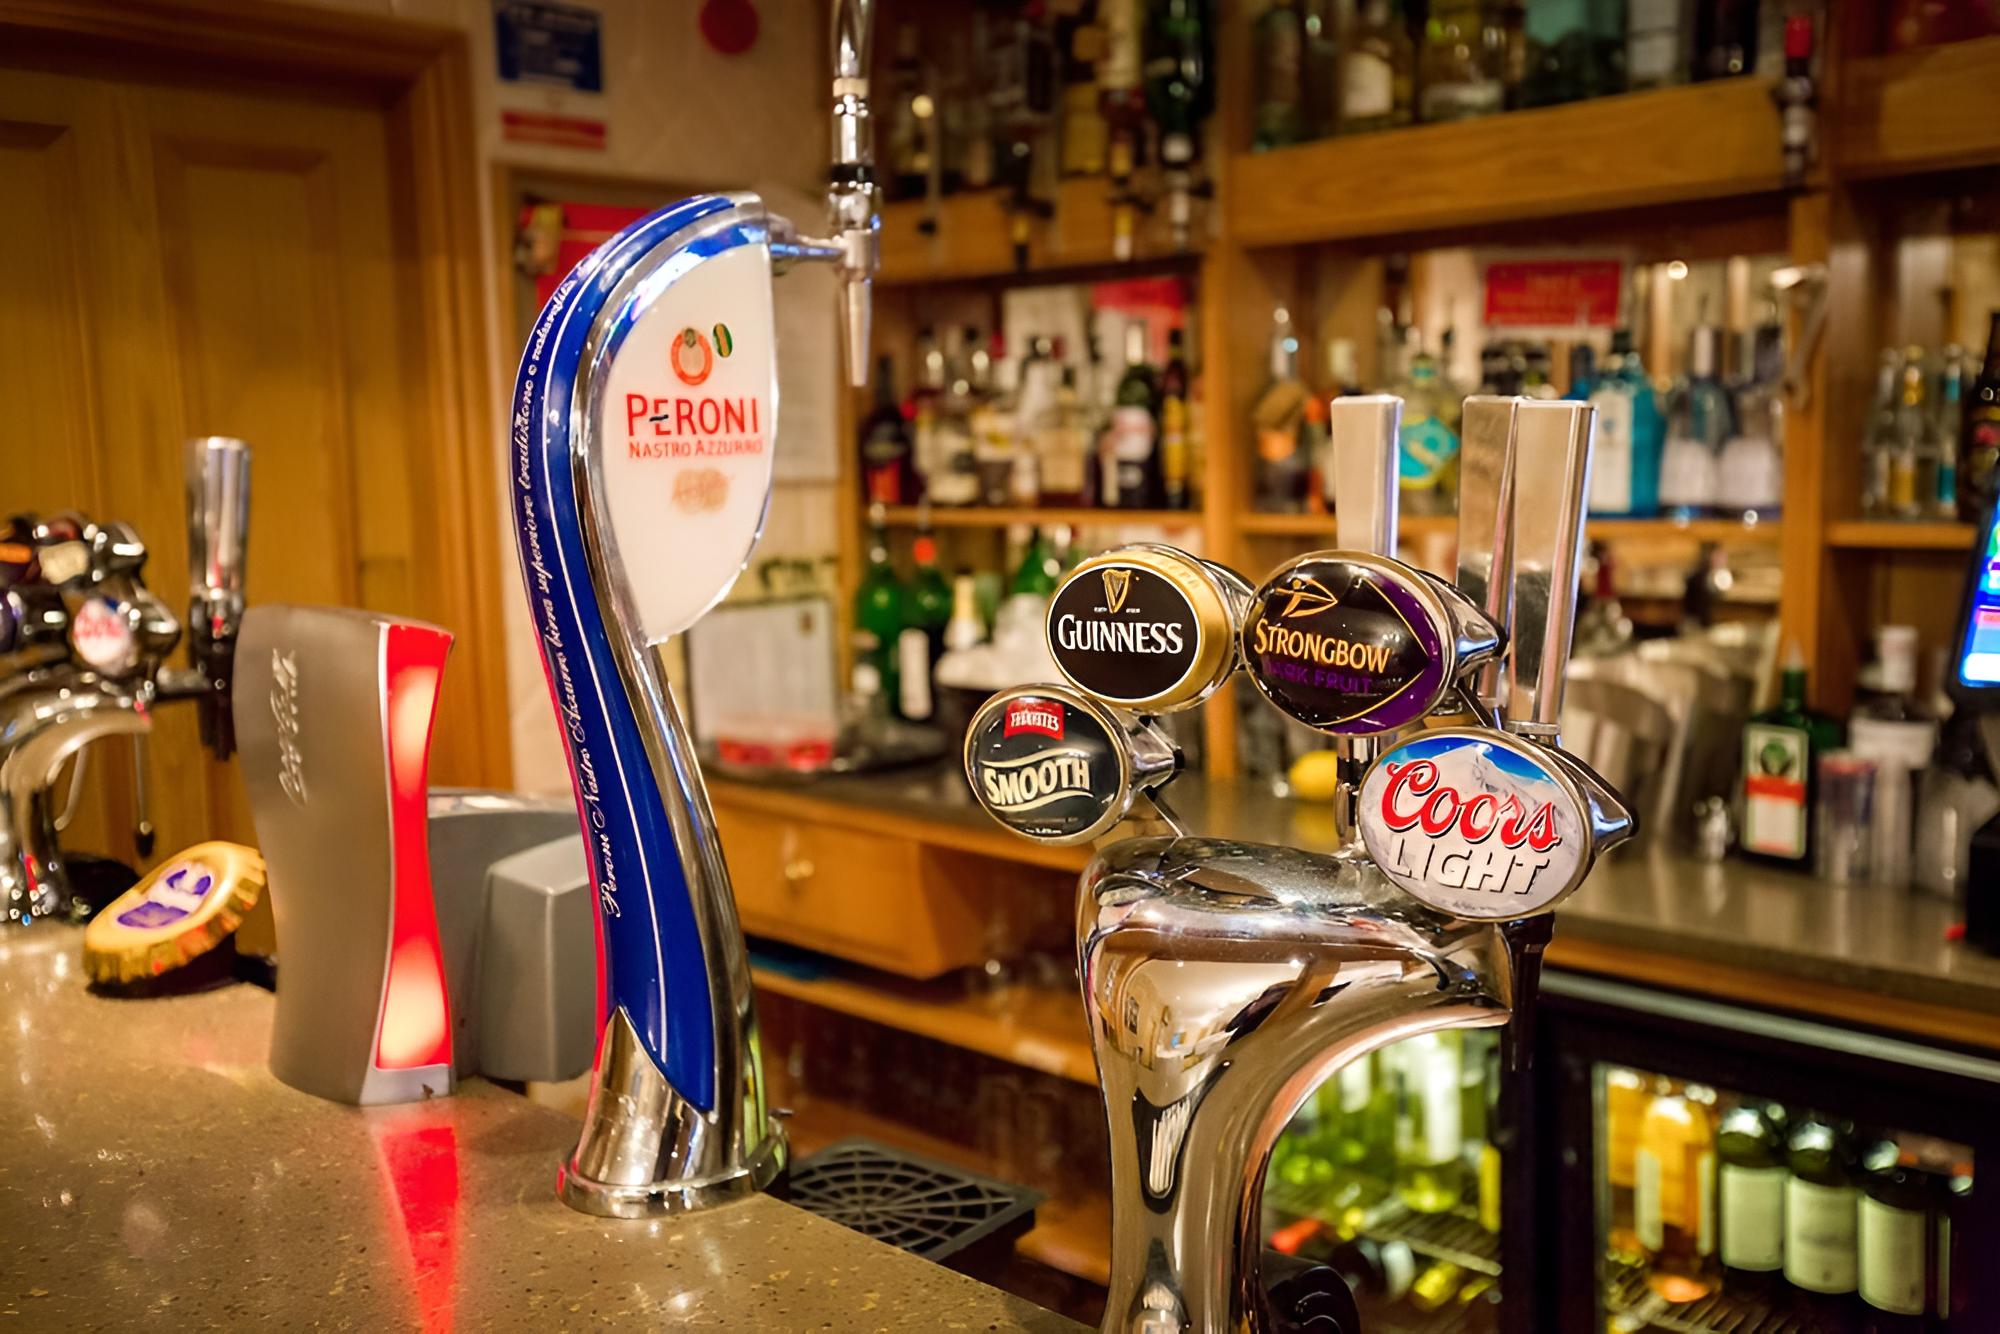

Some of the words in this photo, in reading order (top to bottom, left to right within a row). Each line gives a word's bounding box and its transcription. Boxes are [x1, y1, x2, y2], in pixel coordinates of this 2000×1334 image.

[626, 393, 760, 437] PERONI
[629, 440, 691, 459] NASTRO
[1057, 613, 1184, 655] GUINNESS
[1253, 617, 1391, 674] STRONGBOW
[1314, 669, 1373, 695] FRUIT
[580, 748, 606, 829] Nastro
[983, 756, 1091, 806] SMOOTH
[1381, 758, 1563, 853] Coors
[594, 830, 621, 917] Peroni
[1387, 832, 1551, 895] LIGHT
